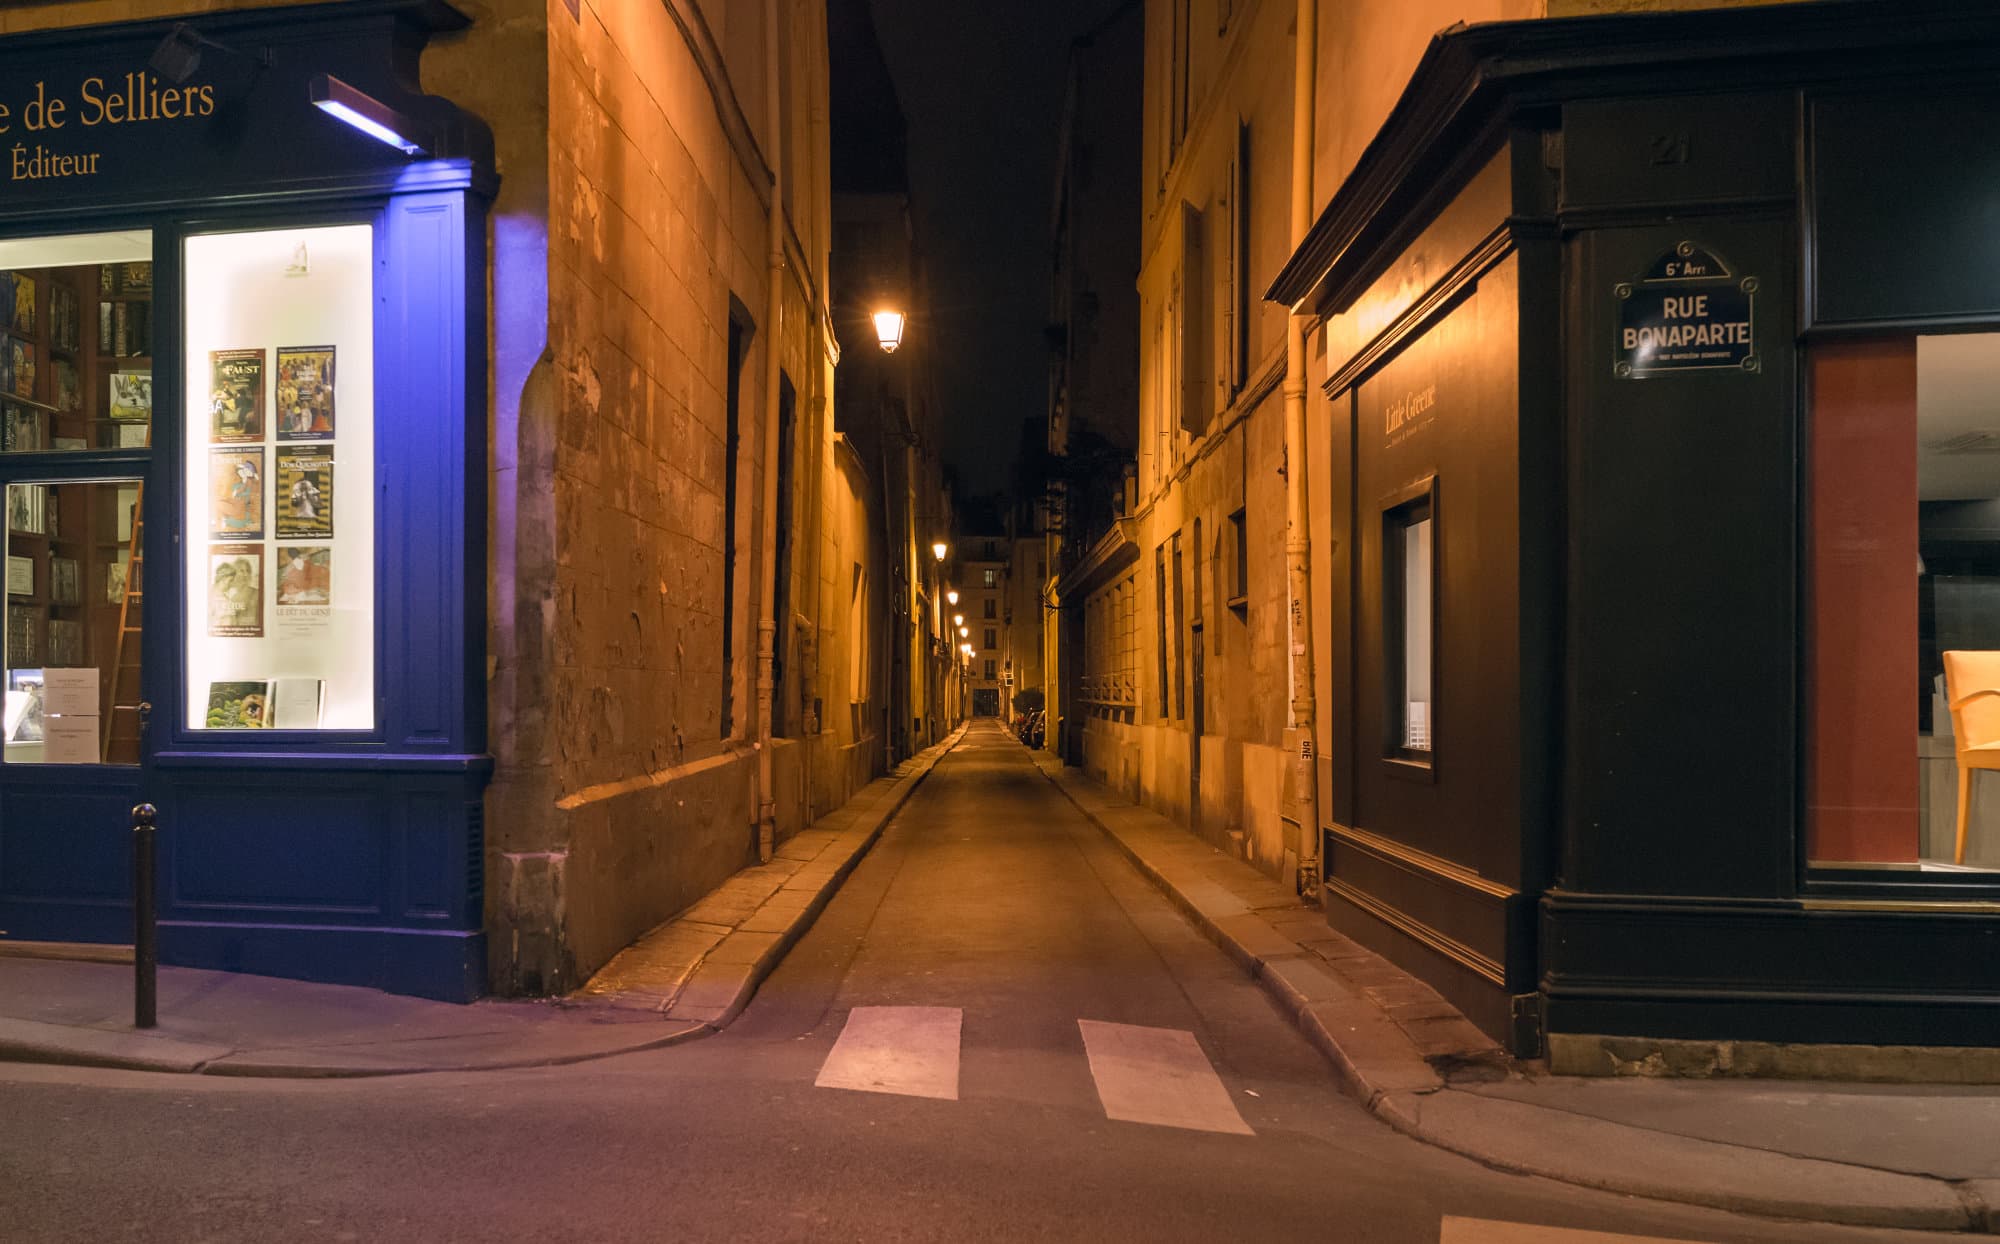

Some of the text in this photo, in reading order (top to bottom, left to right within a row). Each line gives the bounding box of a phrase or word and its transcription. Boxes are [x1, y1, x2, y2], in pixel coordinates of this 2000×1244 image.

[24, 81, 66, 131] de
[80, 71, 215, 126] Selliers
[11, 142, 100, 180] Éditeur
[1663, 295, 1709, 319] RUE
[1623, 322, 1750, 350] BONAPARTE
